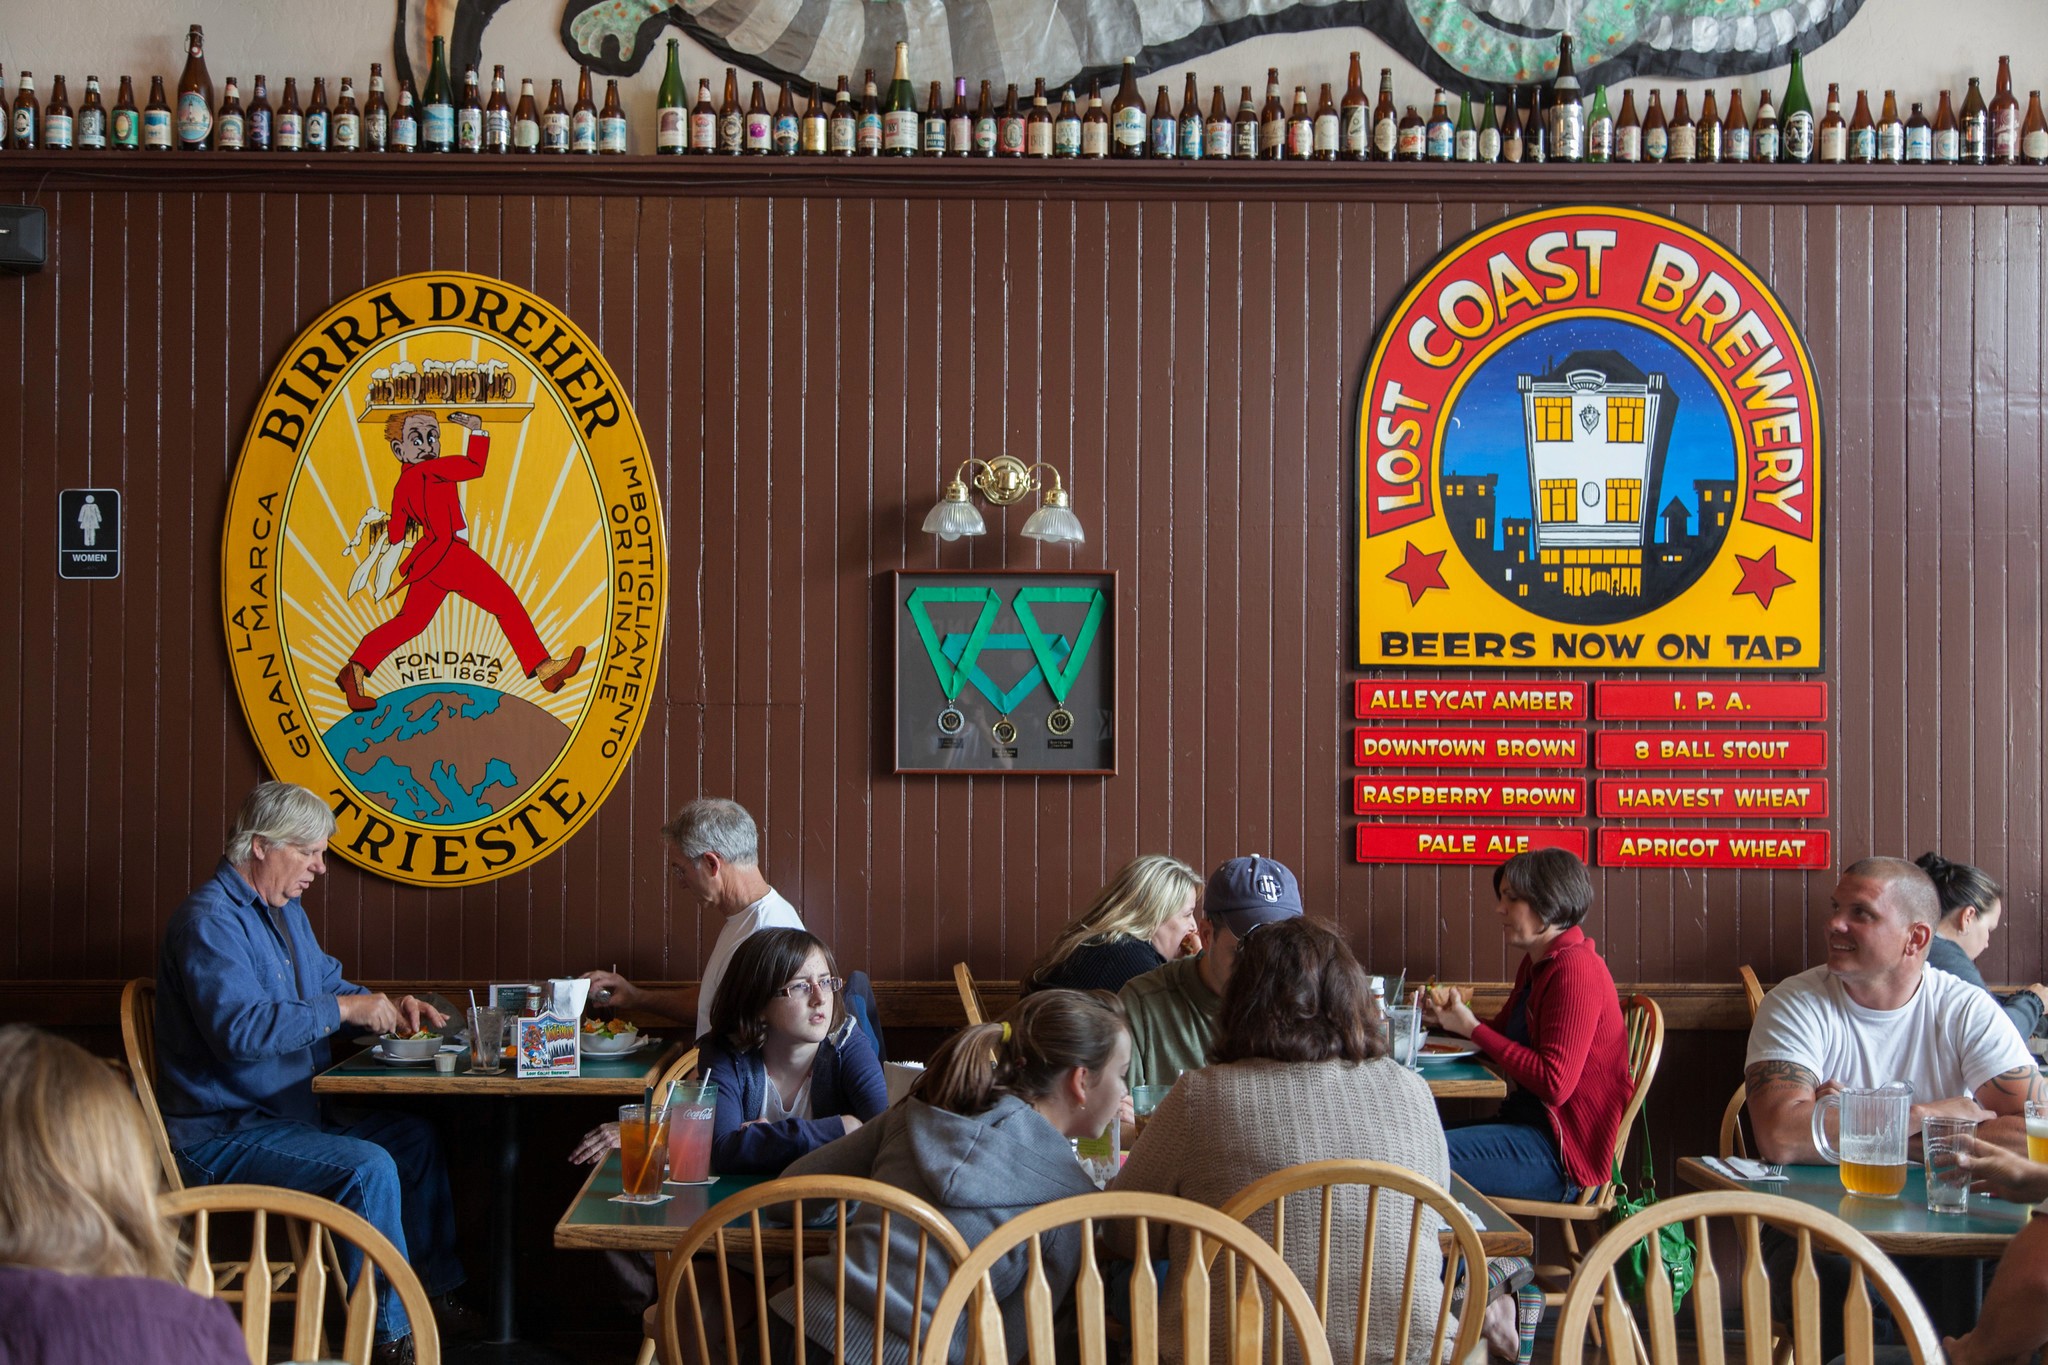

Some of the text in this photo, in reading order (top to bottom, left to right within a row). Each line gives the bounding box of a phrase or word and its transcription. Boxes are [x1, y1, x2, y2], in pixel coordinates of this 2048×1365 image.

[258, 282, 620, 453] BIRRA DREHER
[1376, 229, 1805, 521] LOST COAST BREWERY
[73, 554, 107, 562] WOMEN
[599, 503, 634, 704] ORIGINALE
[601, 457, 655, 760] IMBOTTIGLIAMENTO
[249, 490, 311, 758] GRAN MARCA
[1381, 632, 1802, 661] BEERS NOW ON TAP
[395, 651, 504, 672] FONDATA
[401, 666, 499, 684] NEL 1865
[1370, 690, 1574, 711] ALLEYCAT AMBER
[1364, 738, 1576, 758] DOWNTOWN BROWN
[1634, 741, 1790, 760] 8 BALL STOUT
[1363, 785, 1576, 806] RASPBERRY BROWN
[1617, 787, 1811, 808] HARVEST WHEAT
[329, 777, 587, 876] TRIESTE
[1418, 835, 1530, 854] PALE ALE
[1618, 838, 1806, 858] APRICOT WHEAT
